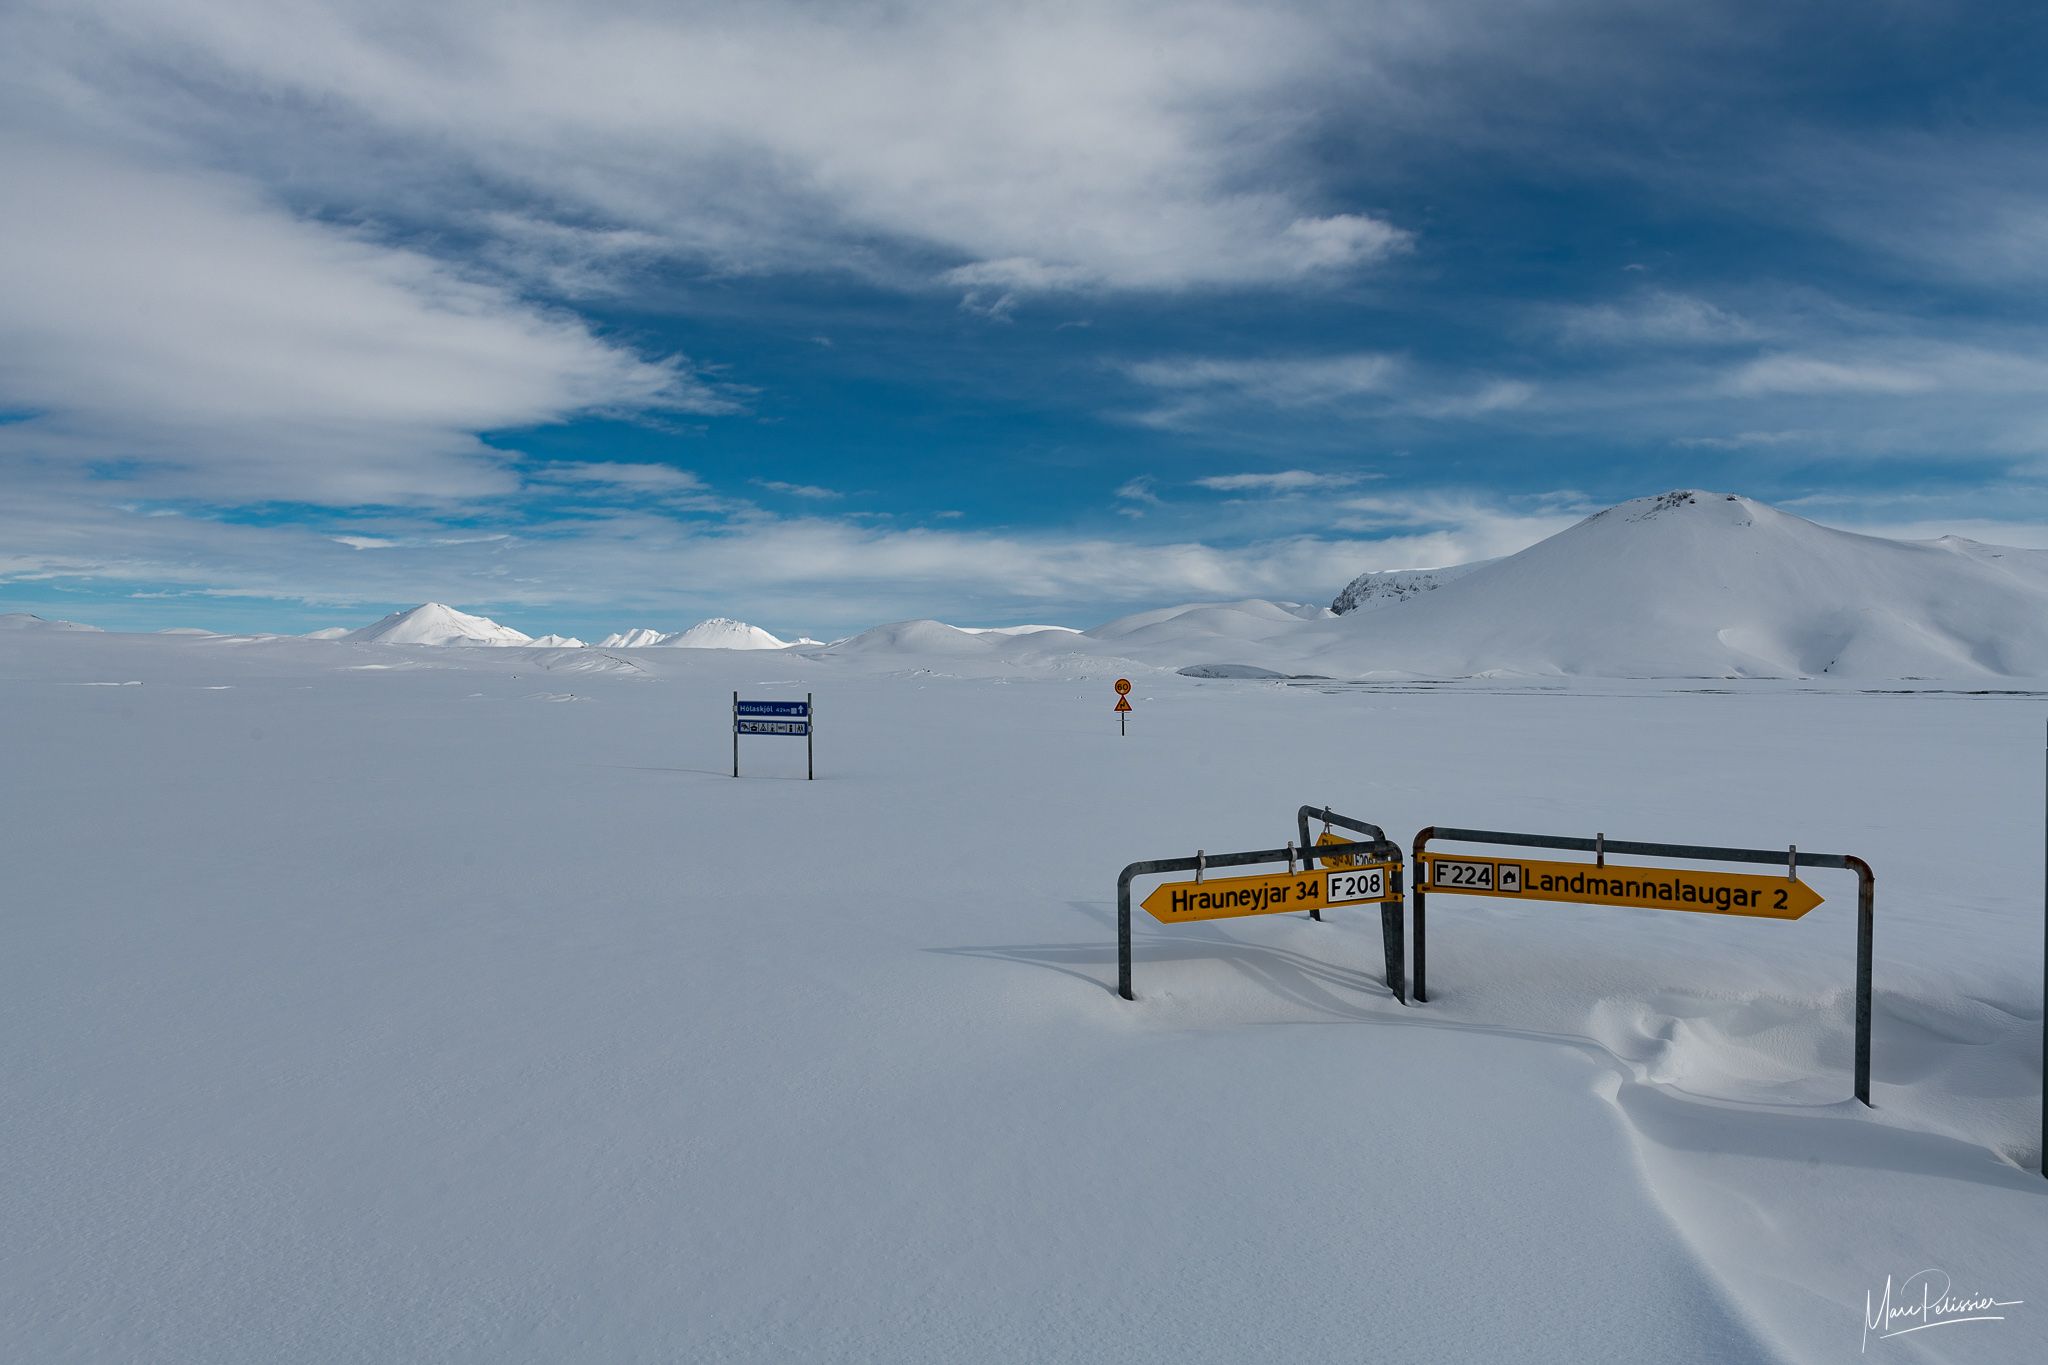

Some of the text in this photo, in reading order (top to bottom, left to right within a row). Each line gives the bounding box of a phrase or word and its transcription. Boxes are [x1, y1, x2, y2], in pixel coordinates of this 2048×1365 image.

[740, 705, 773, 713] Hólaskjól
[1171, 873, 1381, 912] Hrauneyjar 34 F208
[1436, 863, 1788, 911] F224 Landmannalaugar 2
